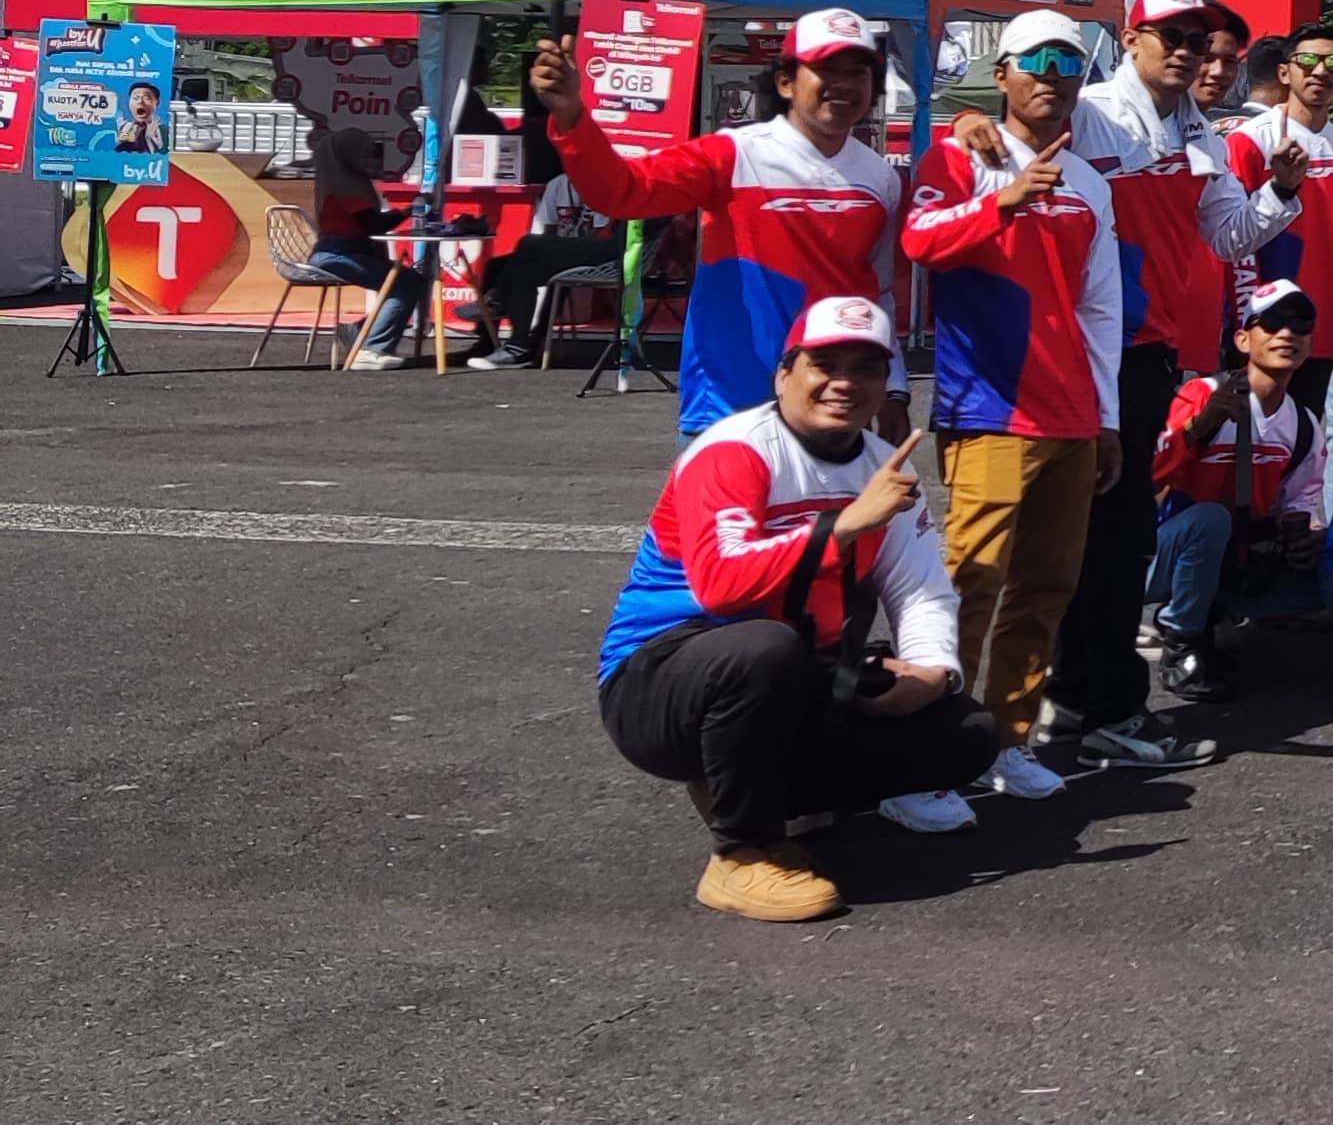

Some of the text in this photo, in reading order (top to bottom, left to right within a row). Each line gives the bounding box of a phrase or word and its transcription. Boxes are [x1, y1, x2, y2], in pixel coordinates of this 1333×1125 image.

[336, 73, 393, 85] Telkomsel
[609, 68, 654, 93] 6GB
[47, 93, 110, 109] KUOTA 7GB
[331, 89, 391, 116] Poin
[123, 159, 162, 181] by.U
